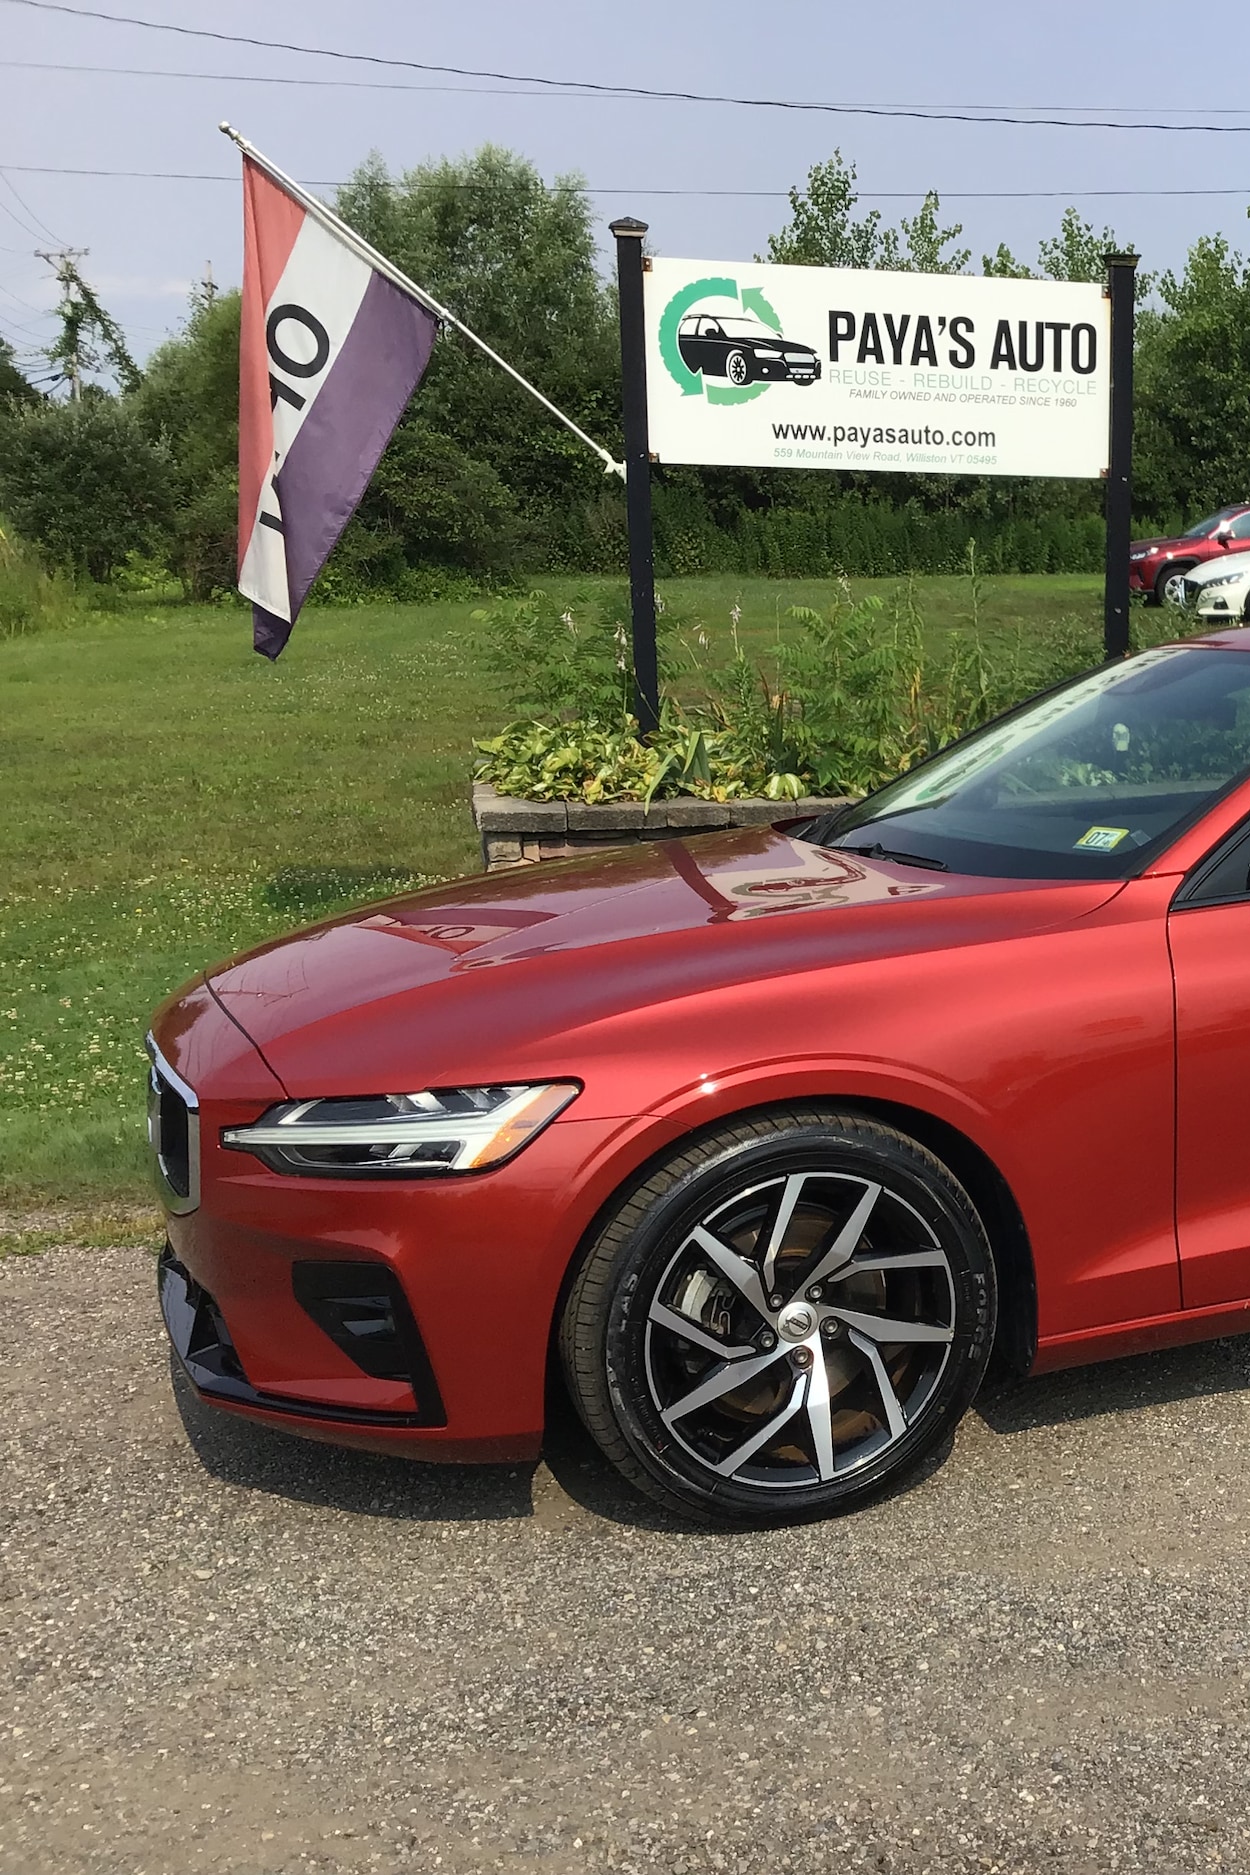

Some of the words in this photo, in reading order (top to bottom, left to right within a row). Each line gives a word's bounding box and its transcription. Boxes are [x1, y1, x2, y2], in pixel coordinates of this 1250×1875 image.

[829, 310, 975, 369] PAYA'S
[990, 319, 1097, 375] AUTO
[829, 369, 891, 386] REUSE
[914, 373, 993, 391] REBUILD
[1014, 378, 1097, 395] RECYCLE
[849, 389, 888, 400] FAMILY
[890, 390, 931, 402] OWNED
[933, 392, 957, 403] AND
[959, 393, 1017, 406] OPERATED
[1019, 396, 1051, 407] SINCE
[1054, 397, 1077, 408] 1960
[772, 423, 996, 448] www.payasauto.com
[773, 448, 793, 458] 559
[796, 448, 842, 460] Mountain
[846, 450, 869, 461] View
[873, 451, 902, 463] Road,
[906, 452, 947, 464] Williston
[950, 454, 965, 464] VT
[966, 455, 998, 465] 05495
[1086, 832, 1109, 845] 07
